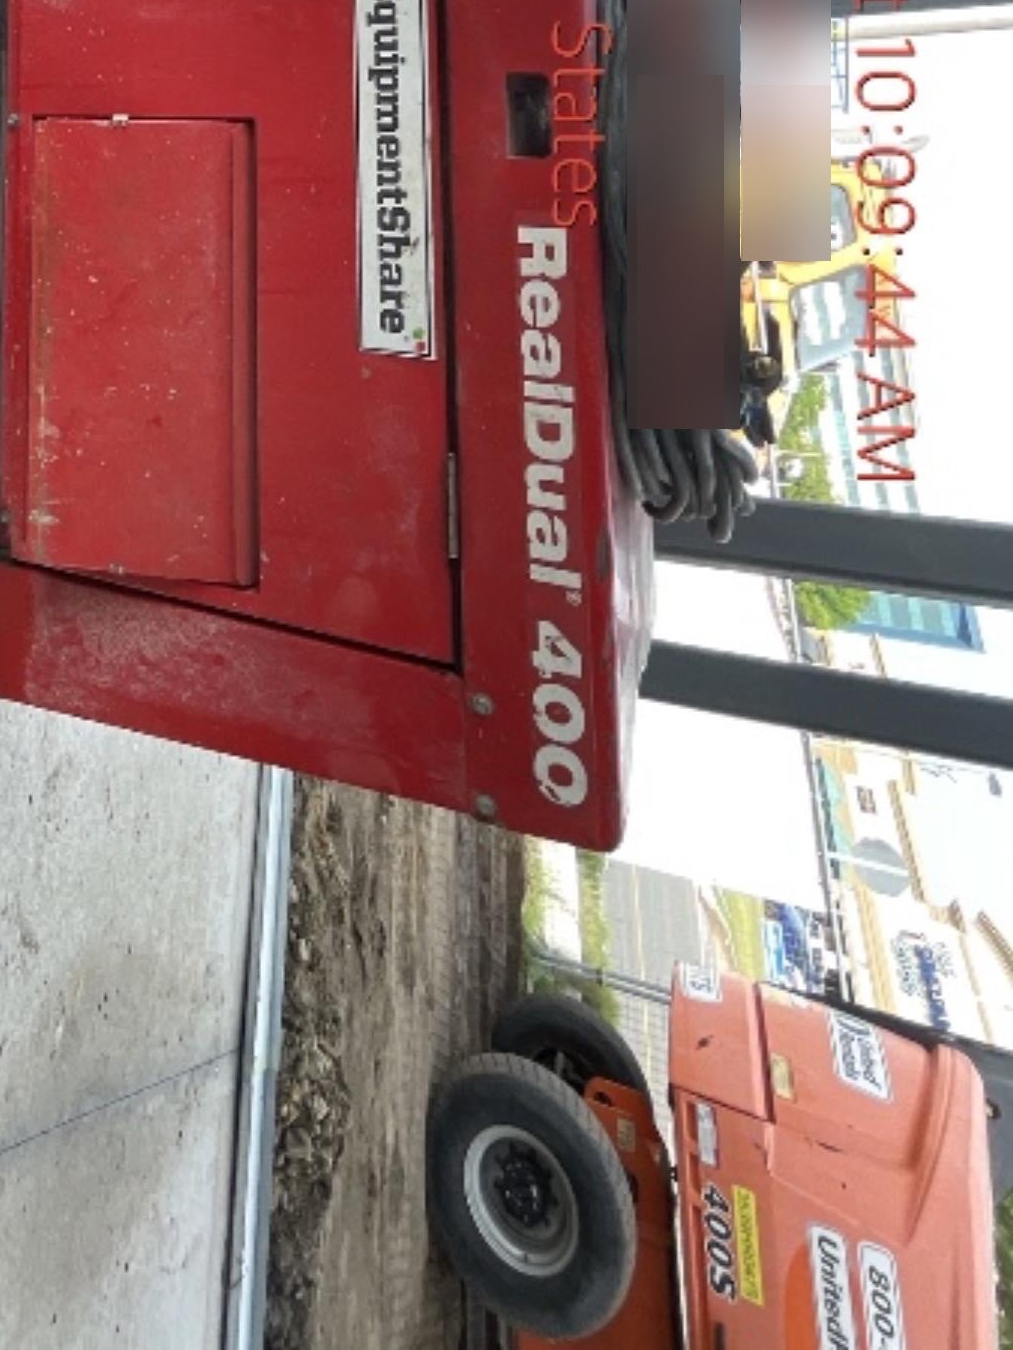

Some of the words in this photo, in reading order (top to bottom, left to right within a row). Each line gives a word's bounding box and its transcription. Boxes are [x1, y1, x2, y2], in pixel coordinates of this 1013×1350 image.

[531, 620, 588, 806] 400
[704, 1183, 737, 1303] 400S
[868, 1265, 896, 1350] 800-
